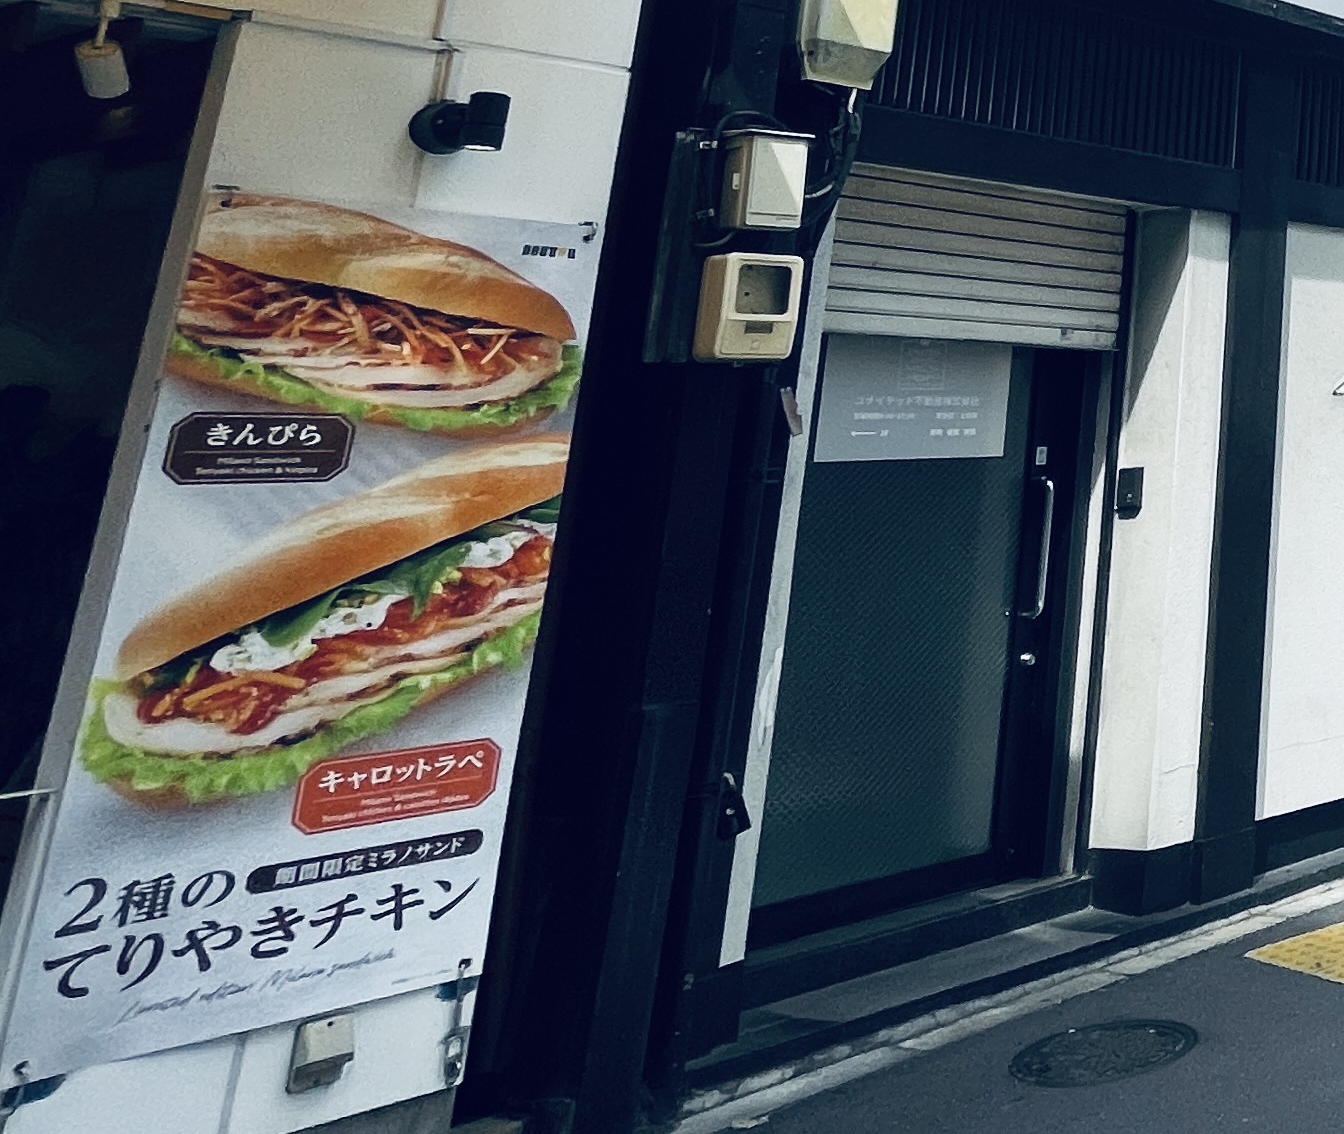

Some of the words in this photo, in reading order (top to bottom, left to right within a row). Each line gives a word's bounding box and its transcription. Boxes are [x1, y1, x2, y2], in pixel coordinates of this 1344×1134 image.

[206, 422, 322, 447] きんぴら
[318, 750, 485, 794] キャロットラペ
[54, 869, 236, 938] 2種の
[43, 876, 480, 998] てりやきチキン
